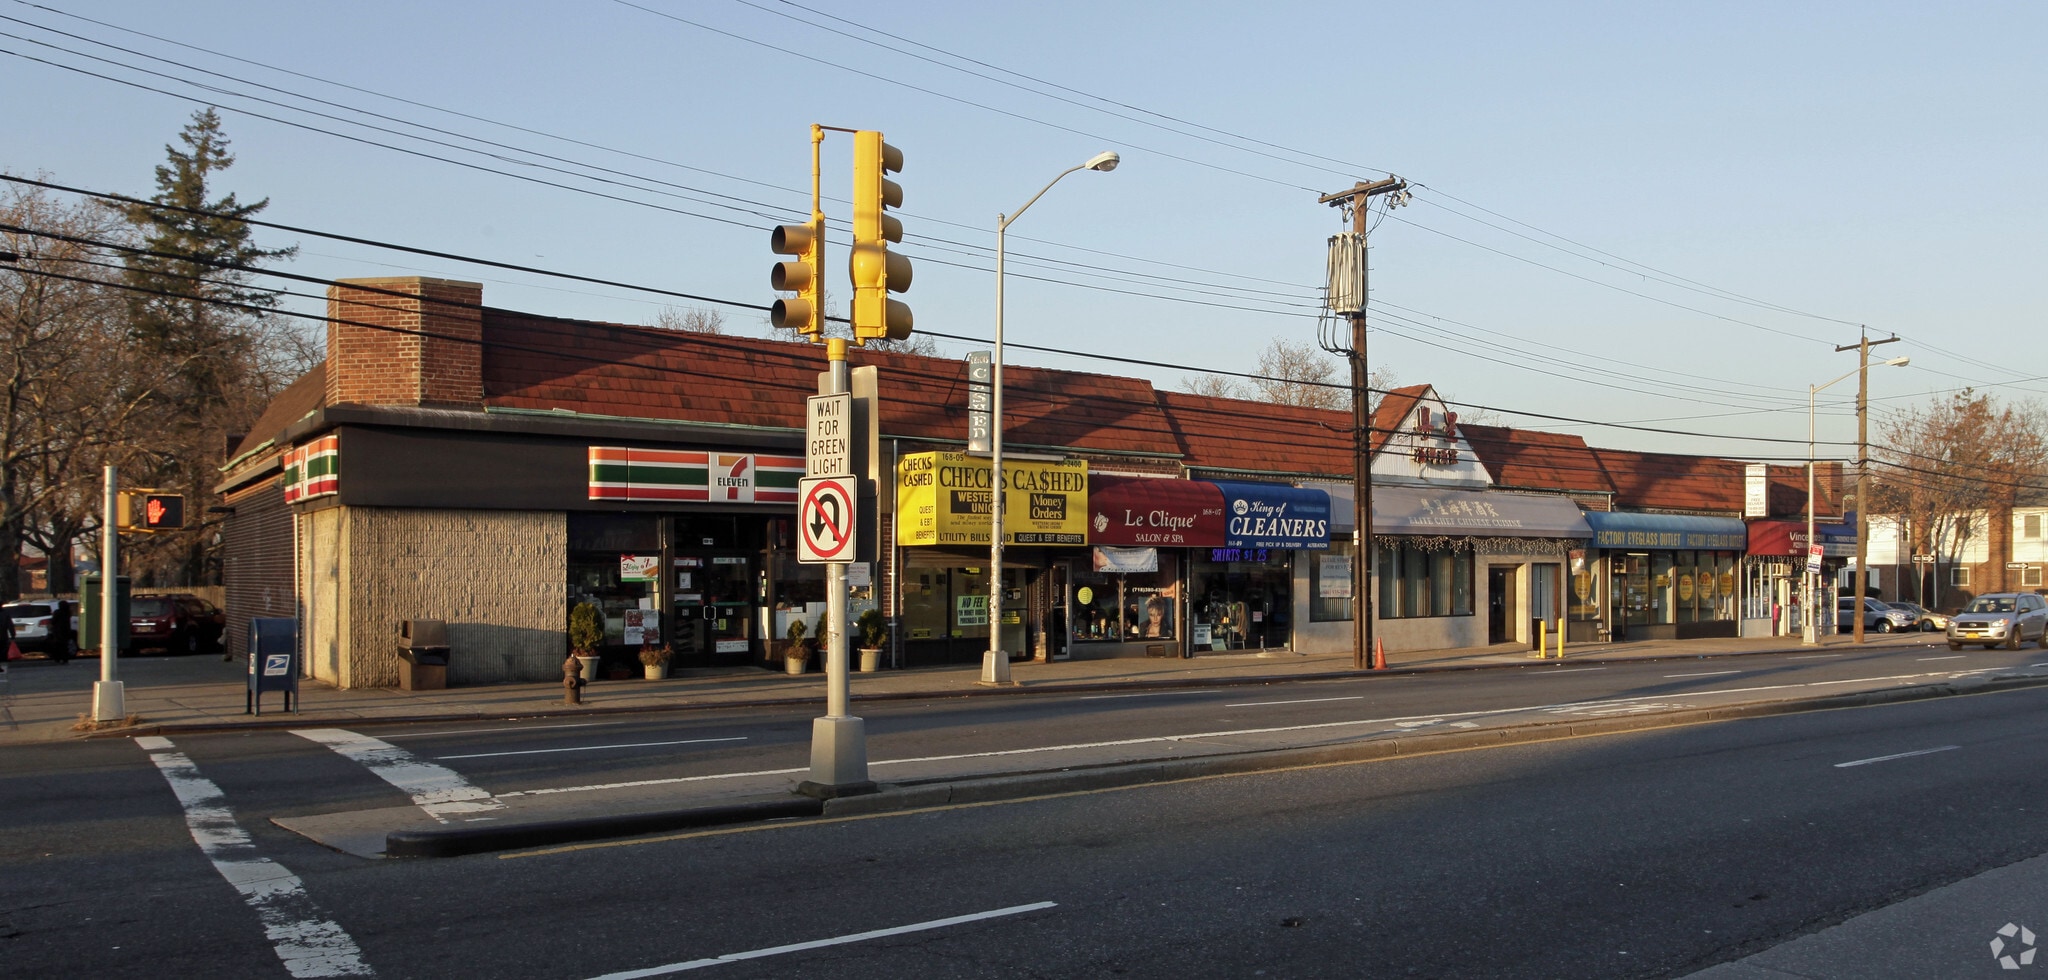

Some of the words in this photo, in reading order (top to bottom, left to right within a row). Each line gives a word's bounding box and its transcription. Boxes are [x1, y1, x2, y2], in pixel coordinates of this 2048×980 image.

[817, 400, 841, 417] WAIT
[818, 420, 839, 436] FOR
[811, 438, 846, 456] GREEN
[942, 453, 964, 461] 168-05
[813, 457, 843, 475] LIGHT
[903, 456, 932, 472] CHECKS
[903, 473, 933, 488] CASHED
[1013, 468, 1084, 493] CA$HED
[957, 491, 993, 503] WESTE
[1032, 494, 1064, 509] Money
[919, 506, 934, 514] QUEST
[1032, 507, 1062, 519] Orders
[1250, 501, 1274, 517] King
[1275, 502, 1287, 517] of
[924, 518, 933, 526] EBT
[1125, 509, 1144, 526] Le
[1408, 516, 1434, 525] ELITE
[1434, 516, 1456, 525] CHEF
[1457, 517, 1491, 527] CHINESE
[1492, 518, 1523, 528] CUISINE
[1229, 516, 1327, 538] CLEANERS
[915, 530, 935, 540] BENEFITS
[939, 533, 967, 541] UTILITY
[970, 533, 990, 542] BILLS
[1018, 534, 1037, 542] QUEST
[1038, 534, 1043, 542] &
[1044, 534, 1055, 542] EBT
[1056, 534, 1082, 543] BENEFITS
[1135, 533, 1161, 543] SALON
[1163, 534, 1169, 543] &
[1171, 534, 1184, 543] SPA
[1597, 531, 1625, 545] FACTORY
[1627, 531, 1659, 546] EYEGLASS
[1660, 532, 1681, 547] OUTLET
[1687, 534, 1706, 546] FACTORY
[1707, 534, 1728, 547] EYEGLASS
[1729, 534, 1744, 547] OUTLET
[1212, 548, 1240, 561] SHIRTS
[962, 597, 972, 608] NO
[973, 597, 984, 608] FEE
